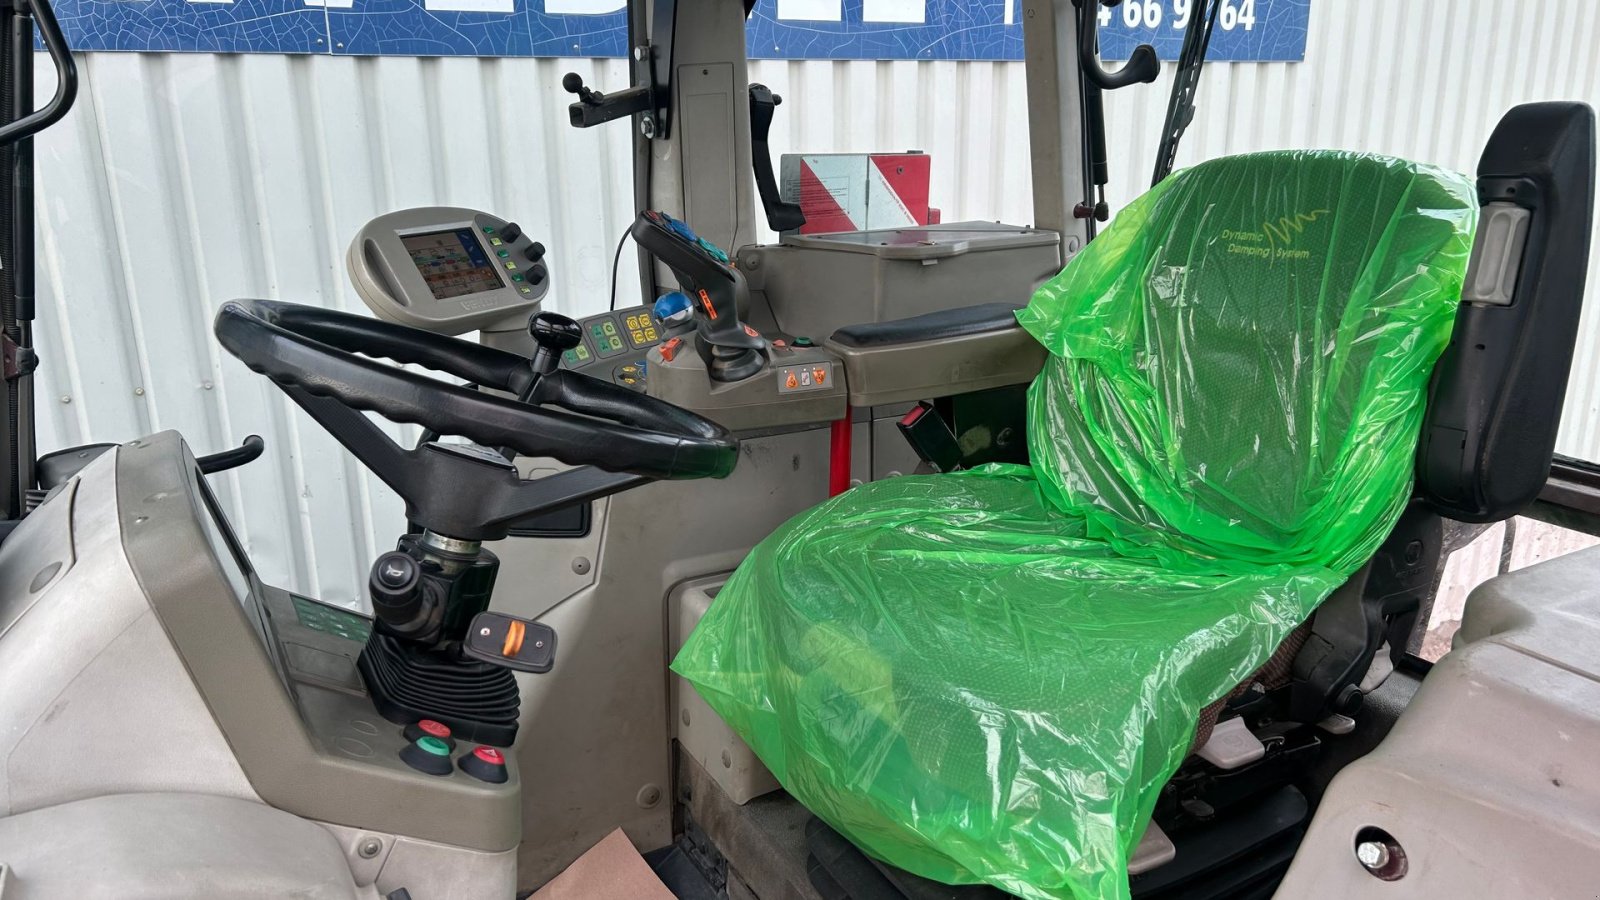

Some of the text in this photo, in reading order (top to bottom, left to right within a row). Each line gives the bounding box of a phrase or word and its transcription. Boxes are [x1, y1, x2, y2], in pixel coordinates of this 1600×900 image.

[1123, 0, 1162, 28] 66
[1173, 0, 1209, 30] 9
[1219, 0, 1255, 31] 64
[1221, 229, 1264, 242] Dynamic
[1228, 243, 1310, 259] Damping System
